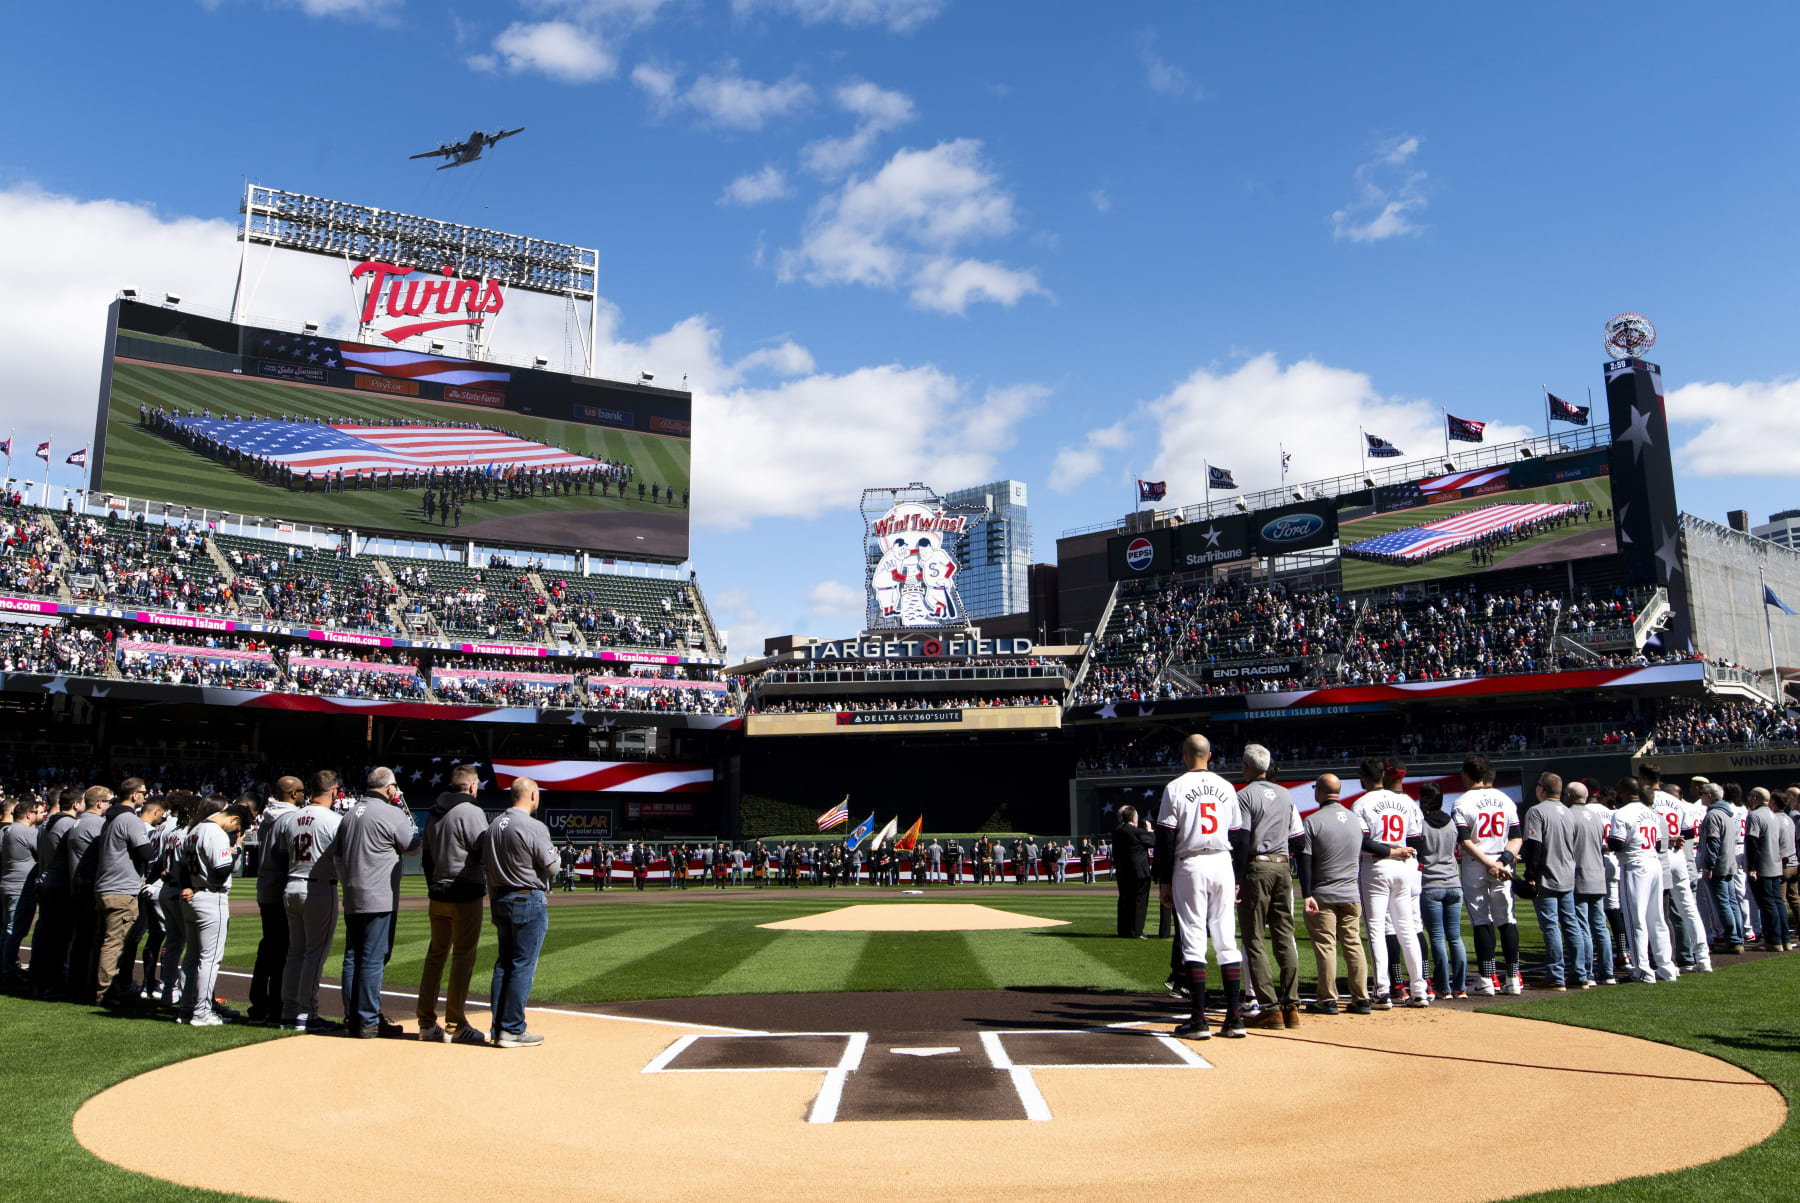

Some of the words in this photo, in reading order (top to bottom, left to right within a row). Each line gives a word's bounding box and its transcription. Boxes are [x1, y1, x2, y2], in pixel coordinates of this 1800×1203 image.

[352, 261, 504, 324] Twins
[874, 512, 910, 536] Win!
[911, 511, 965, 532] Twins!
[1272, 518, 1311, 540] Ford
[1128, 549, 1152, 560] PEPSI
[149, 613, 194, 627] Treasure
[195, 617, 227, 631] Island
[471, 644, 511, 656] Treasure
[512, 647, 539, 657] Island
[808, 641, 920, 658] TARGET
[949, 638, 1033, 656] FIELD
[1213, 669, 1239, 678] END
[1241, 664, 1290, 676] RACISM
[864, 714, 895, 722] DELTA
[1244, 710, 1286, 719] TREASURE
[1291, 708, 1322, 716] ISLAND
[1327, 706, 1350, 714] COVE
[1185, 784, 1229, 804] BALDELLI
[1372, 800, 1409, 815] KIRILLOFF
[1476, 798, 1504, 811] KEPLER
[1200, 803, 1218, 834] 5
[1381, 814, 1405, 842] 19
[1478, 811, 1505, 838] 26
[293, 832, 313, 862] 12
[1640, 826, 1657, 850] 30
